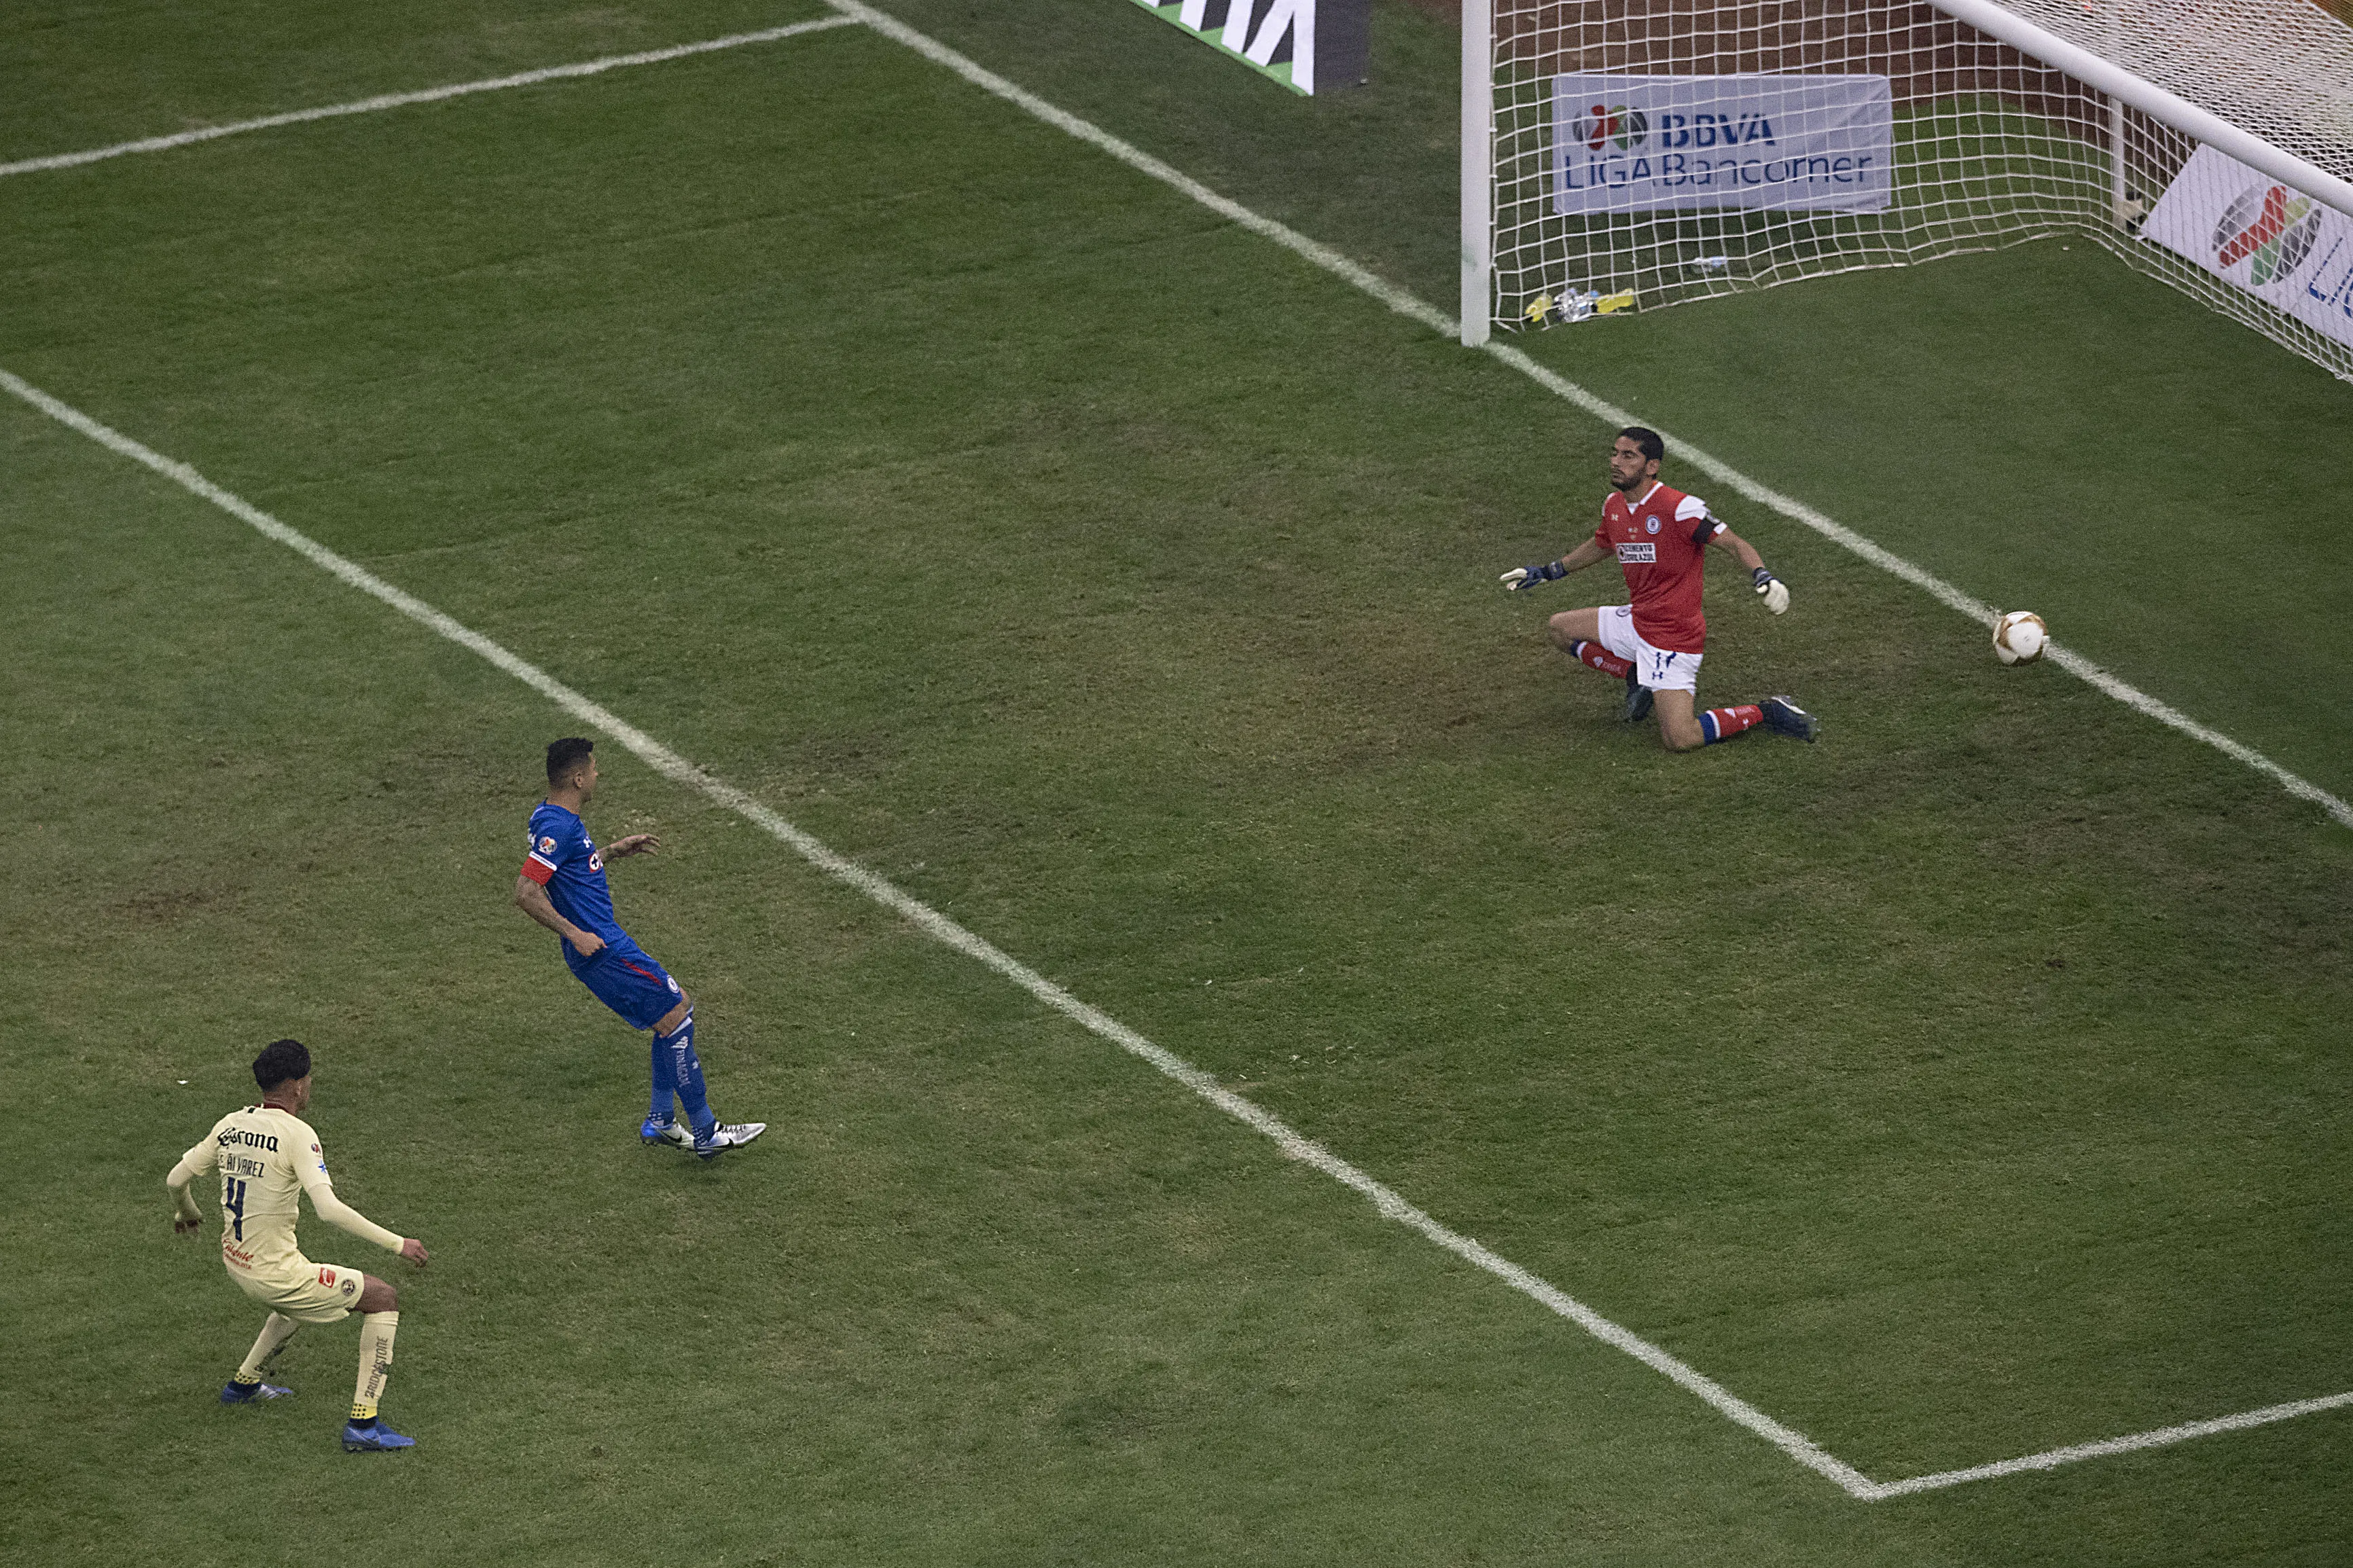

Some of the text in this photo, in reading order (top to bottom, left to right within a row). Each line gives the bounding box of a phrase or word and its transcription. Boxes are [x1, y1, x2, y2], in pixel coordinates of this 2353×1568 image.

[1662, 113, 1776, 147] BBVA
[1564, 153, 1872, 189] LIGA Bancomer
[217, 1127, 279, 1153] Corona
[225, 1176, 247, 1243] 4
